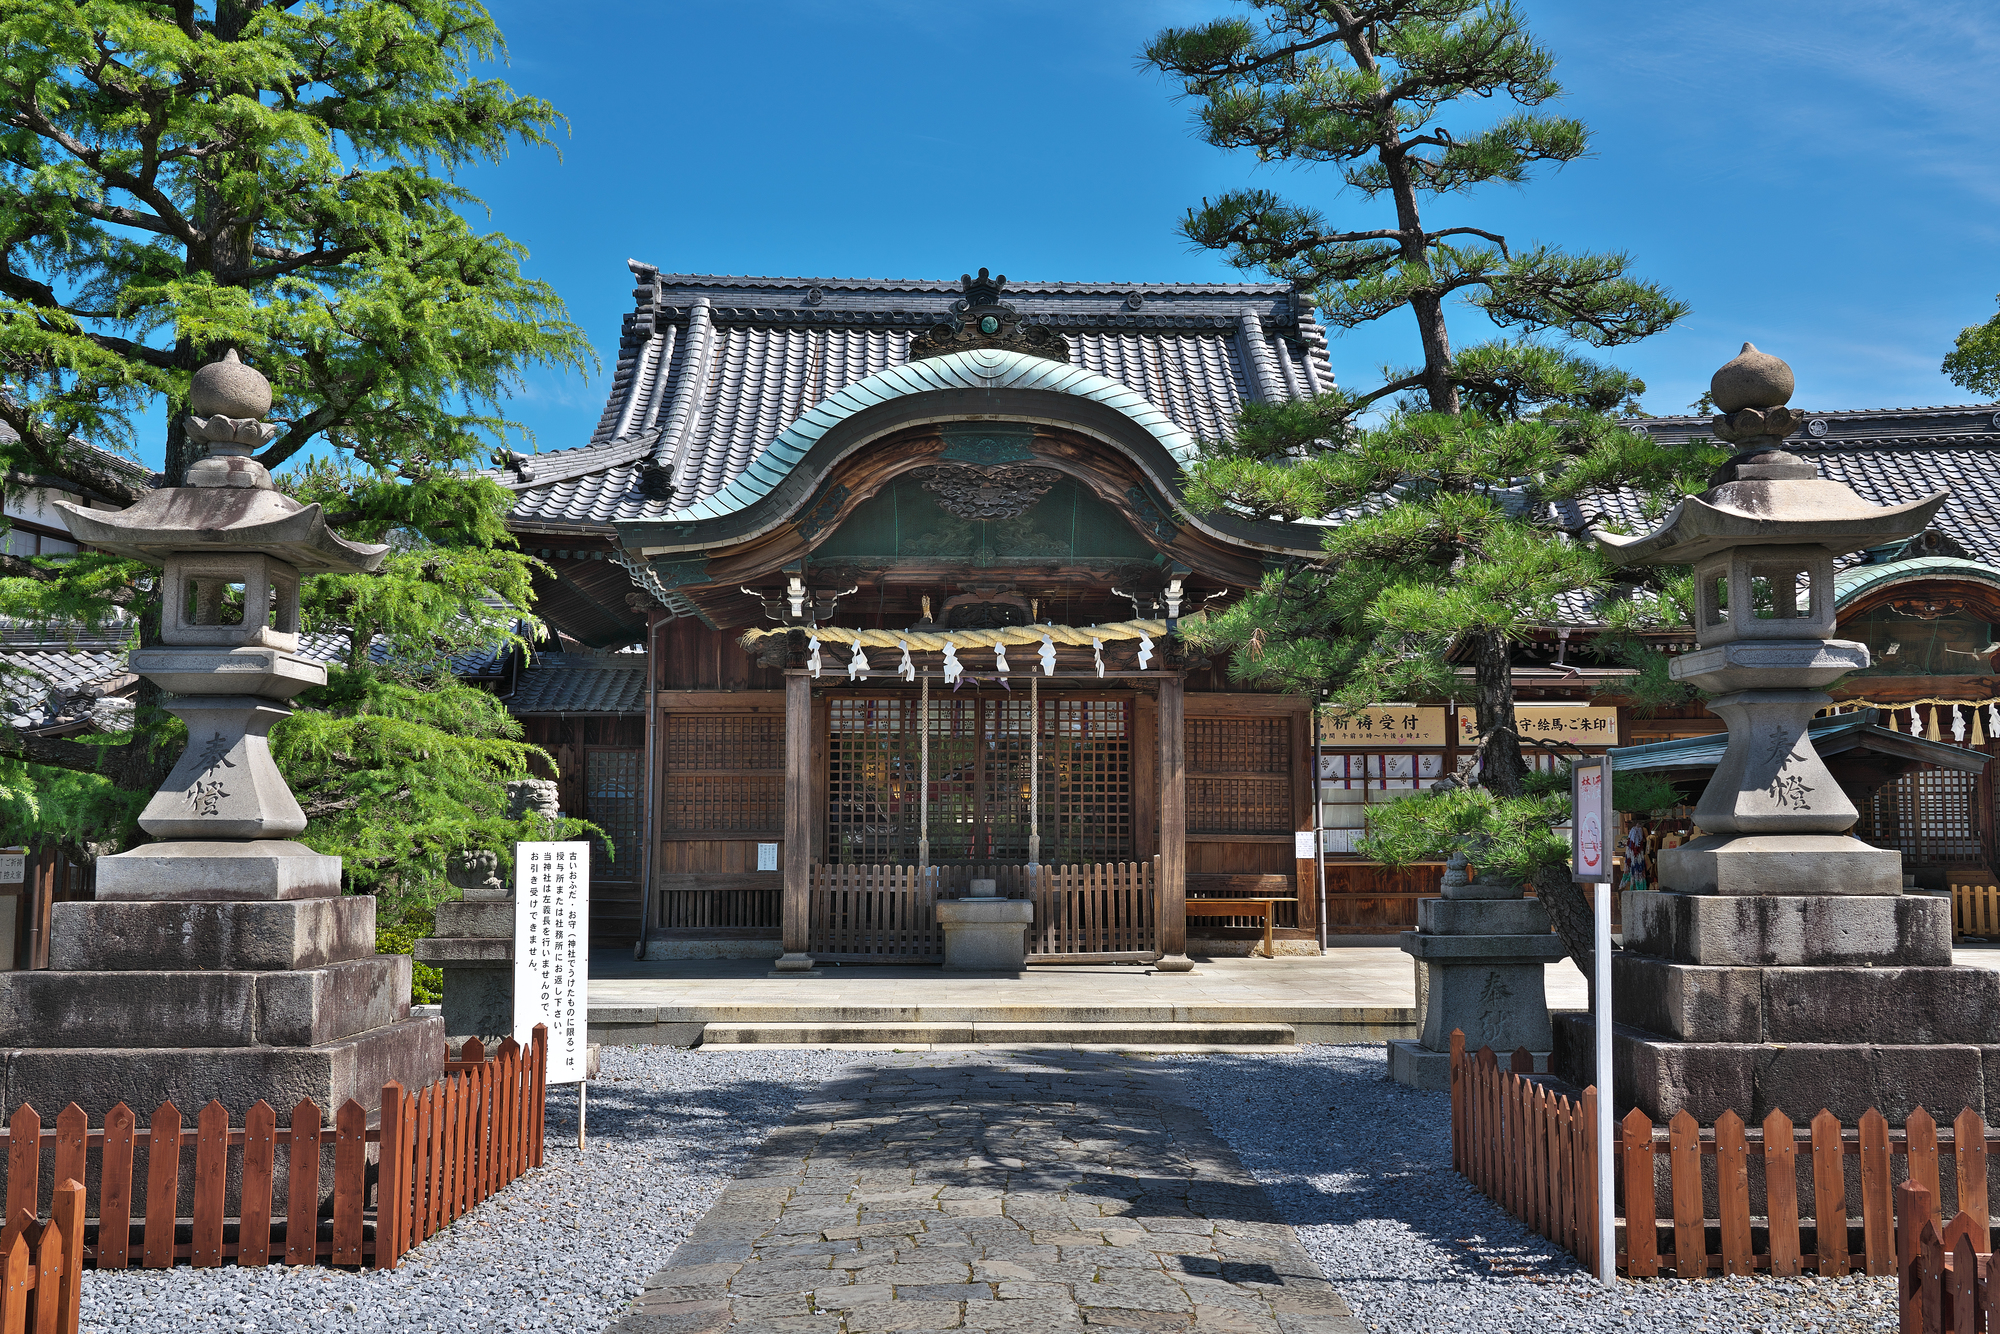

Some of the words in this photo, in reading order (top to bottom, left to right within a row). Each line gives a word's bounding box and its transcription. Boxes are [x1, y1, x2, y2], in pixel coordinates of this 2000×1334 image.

[1320, 714, 1419, 731] 祈祷受付
[1514, 717, 1606, 732] 守・絵馬・ご朱印
